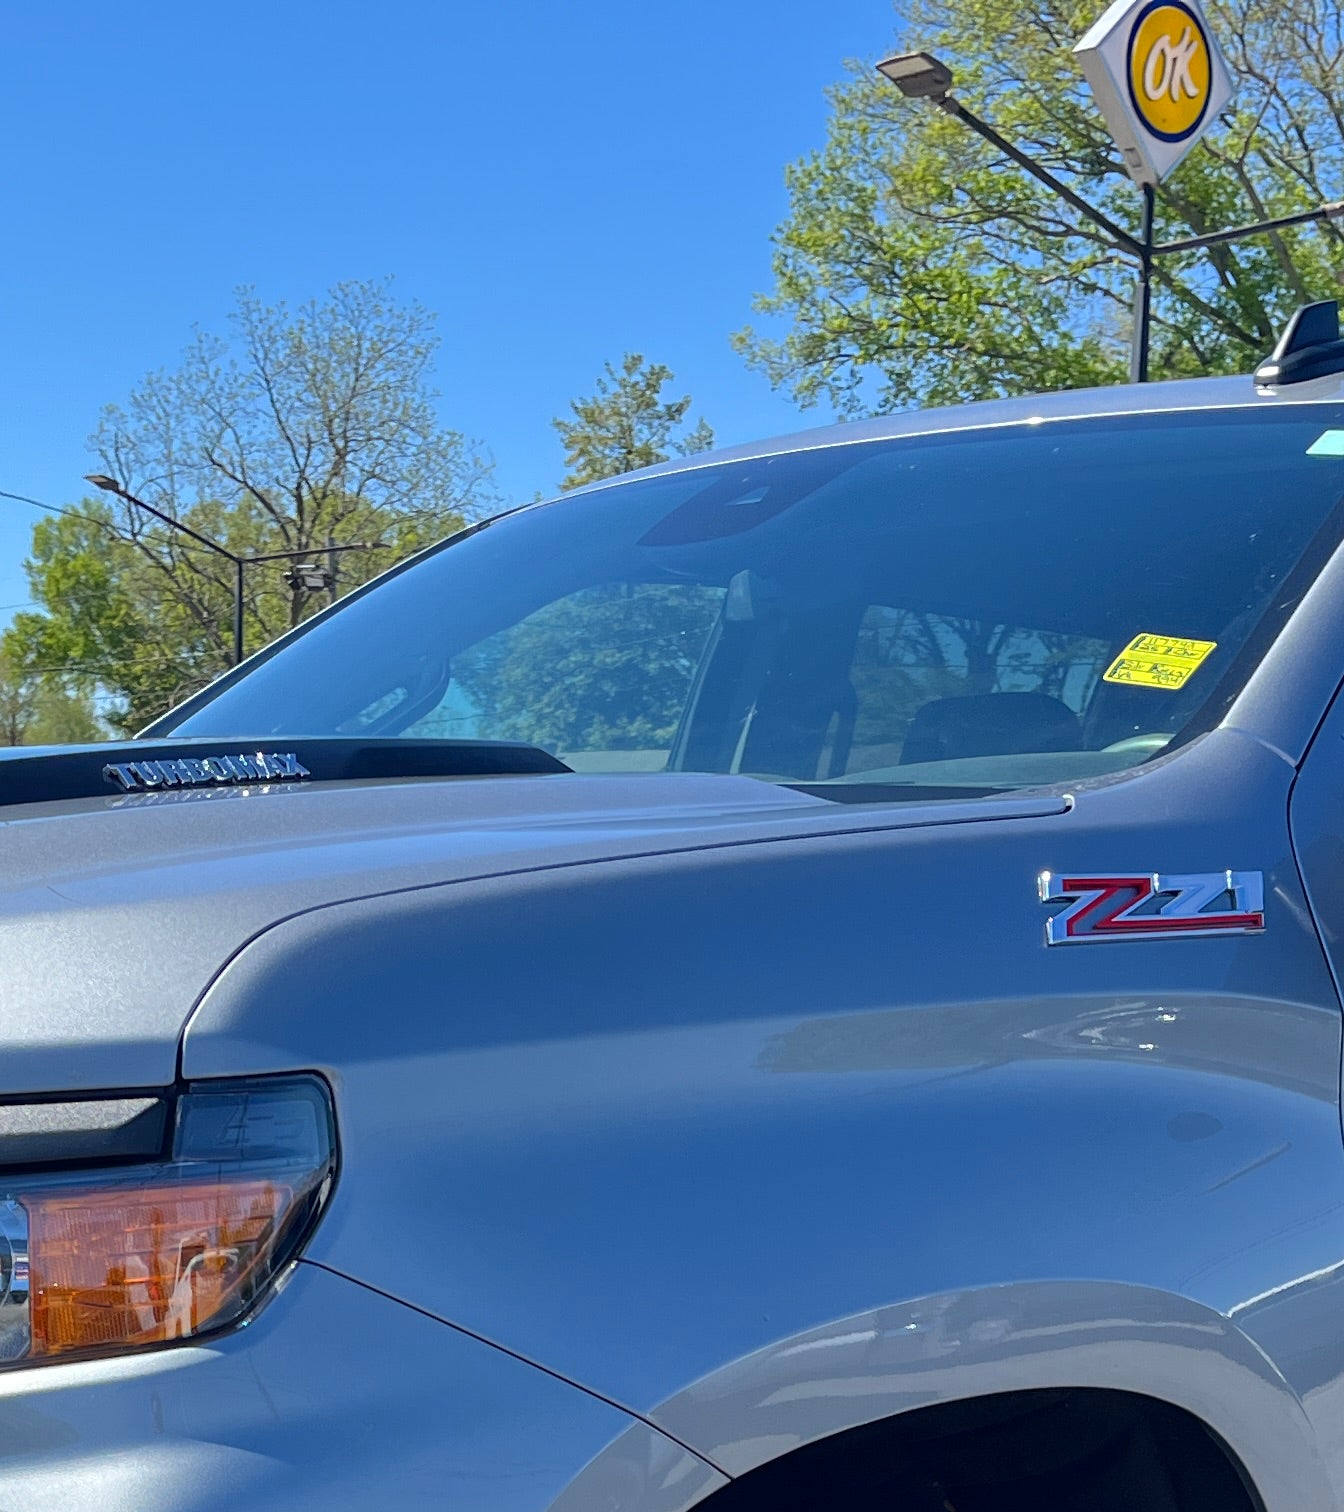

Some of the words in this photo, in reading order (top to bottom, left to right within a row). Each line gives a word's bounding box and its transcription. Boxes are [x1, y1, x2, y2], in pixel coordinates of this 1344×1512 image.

[1144, 26, 1199, 103] OK
[102, 751, 311, 790] TURBOMAX
[1038, 870, 1266, 947] Z71
